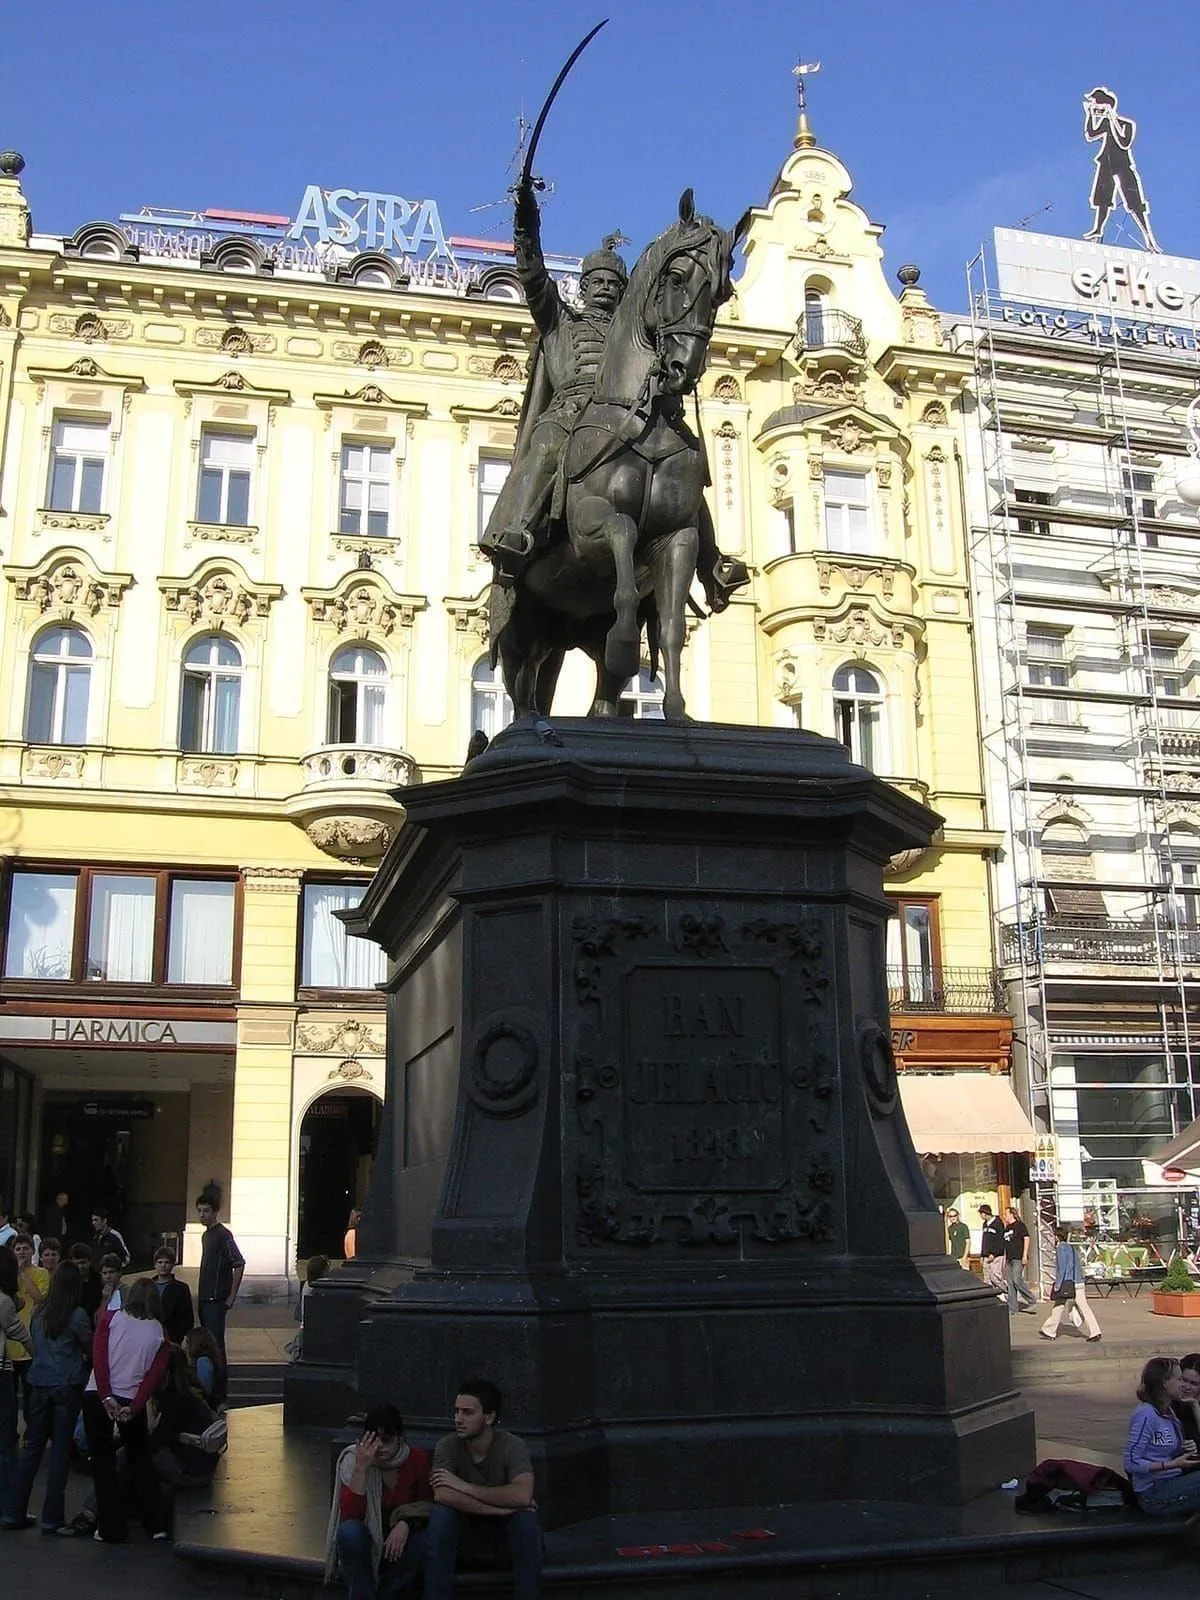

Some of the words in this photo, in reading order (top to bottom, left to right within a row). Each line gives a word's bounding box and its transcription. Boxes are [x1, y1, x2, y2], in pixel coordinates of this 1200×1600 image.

[290, 184, 450, 258] ASTRA
[1002, 306, 1070, 329] FOTO
[50, 1018, 178, 1044] HARMICA
[662, 993, 747, 1038] BAN
